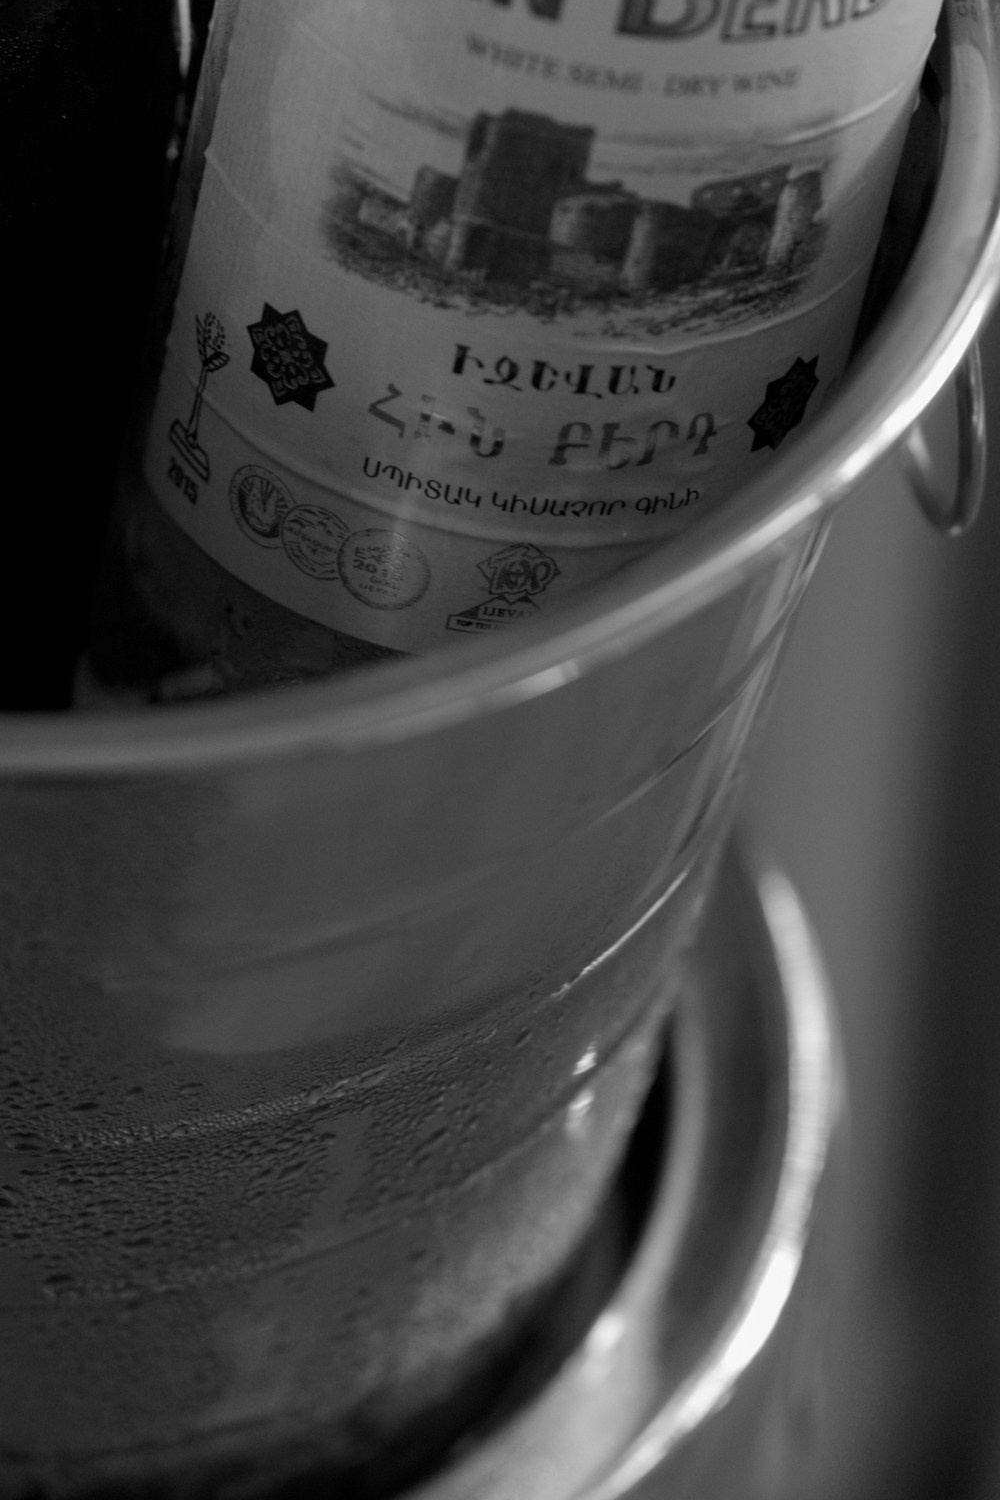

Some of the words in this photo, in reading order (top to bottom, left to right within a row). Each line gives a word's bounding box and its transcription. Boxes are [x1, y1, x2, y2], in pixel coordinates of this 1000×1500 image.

[450, 342, 677, 400] ԻՋԵՎԱՆ
[361, 455, 483, 509] ՍՊԻՏԱԿ
[635, 486, 701, 516] ԳԻՆԻ
